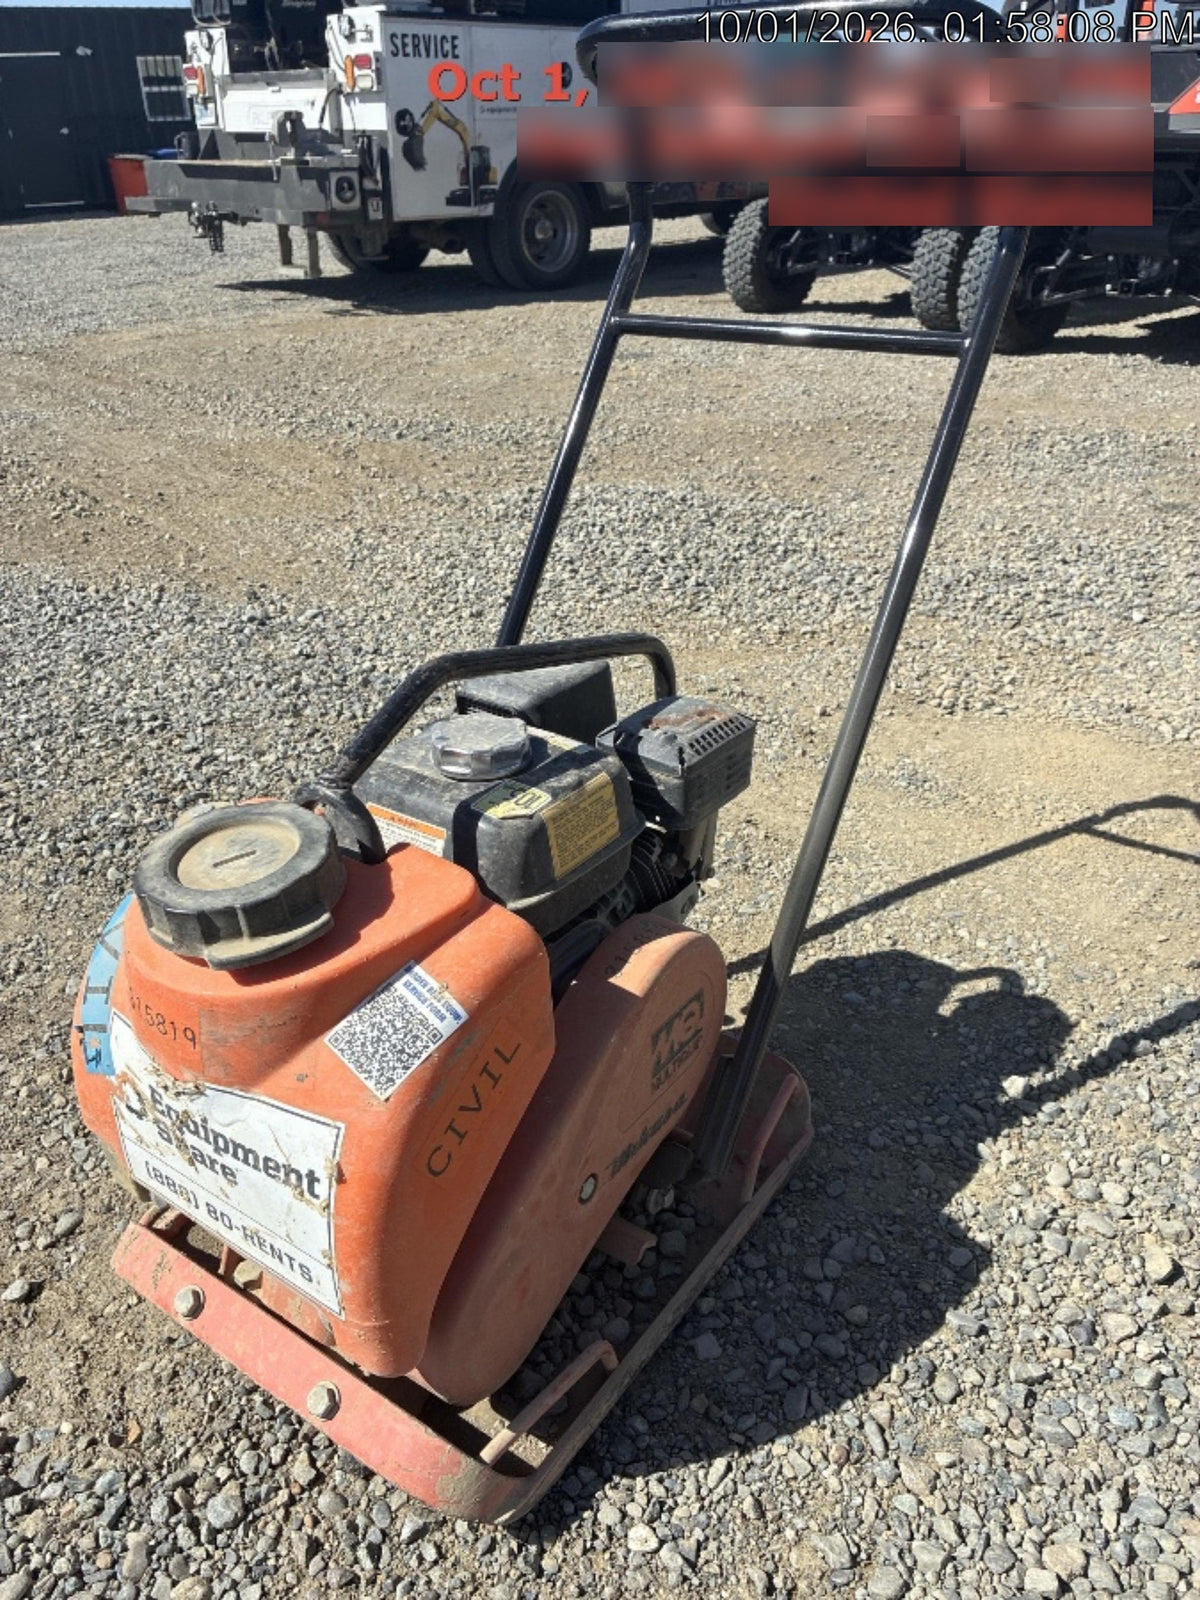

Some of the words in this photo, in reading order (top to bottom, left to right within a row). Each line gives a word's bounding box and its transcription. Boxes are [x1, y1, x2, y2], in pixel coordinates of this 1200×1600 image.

[390, 33, 460, 59] SERVICE
[148, 1084, 322, 1199] Equipment
[157, 1122, 238, 1187] Sare
[426, 1043, 521, 1178] CIVIL
